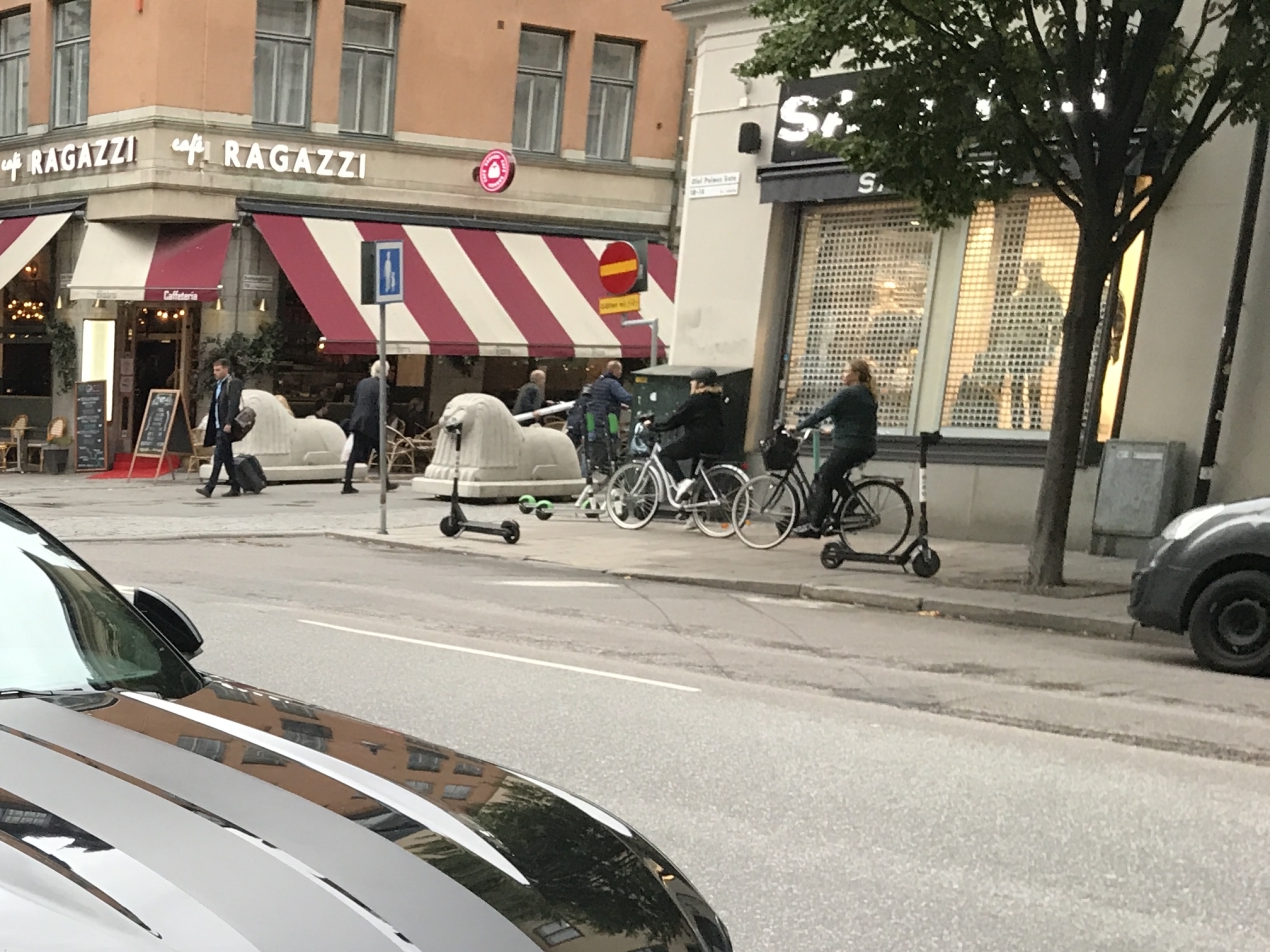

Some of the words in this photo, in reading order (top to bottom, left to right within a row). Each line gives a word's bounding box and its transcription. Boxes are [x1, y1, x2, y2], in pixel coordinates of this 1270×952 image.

[31, 135, 135, 175] RAGAZZI
[224, 139, 366, 179] RAGAZZI
[163, 290, 198, 301] Caffeteria
